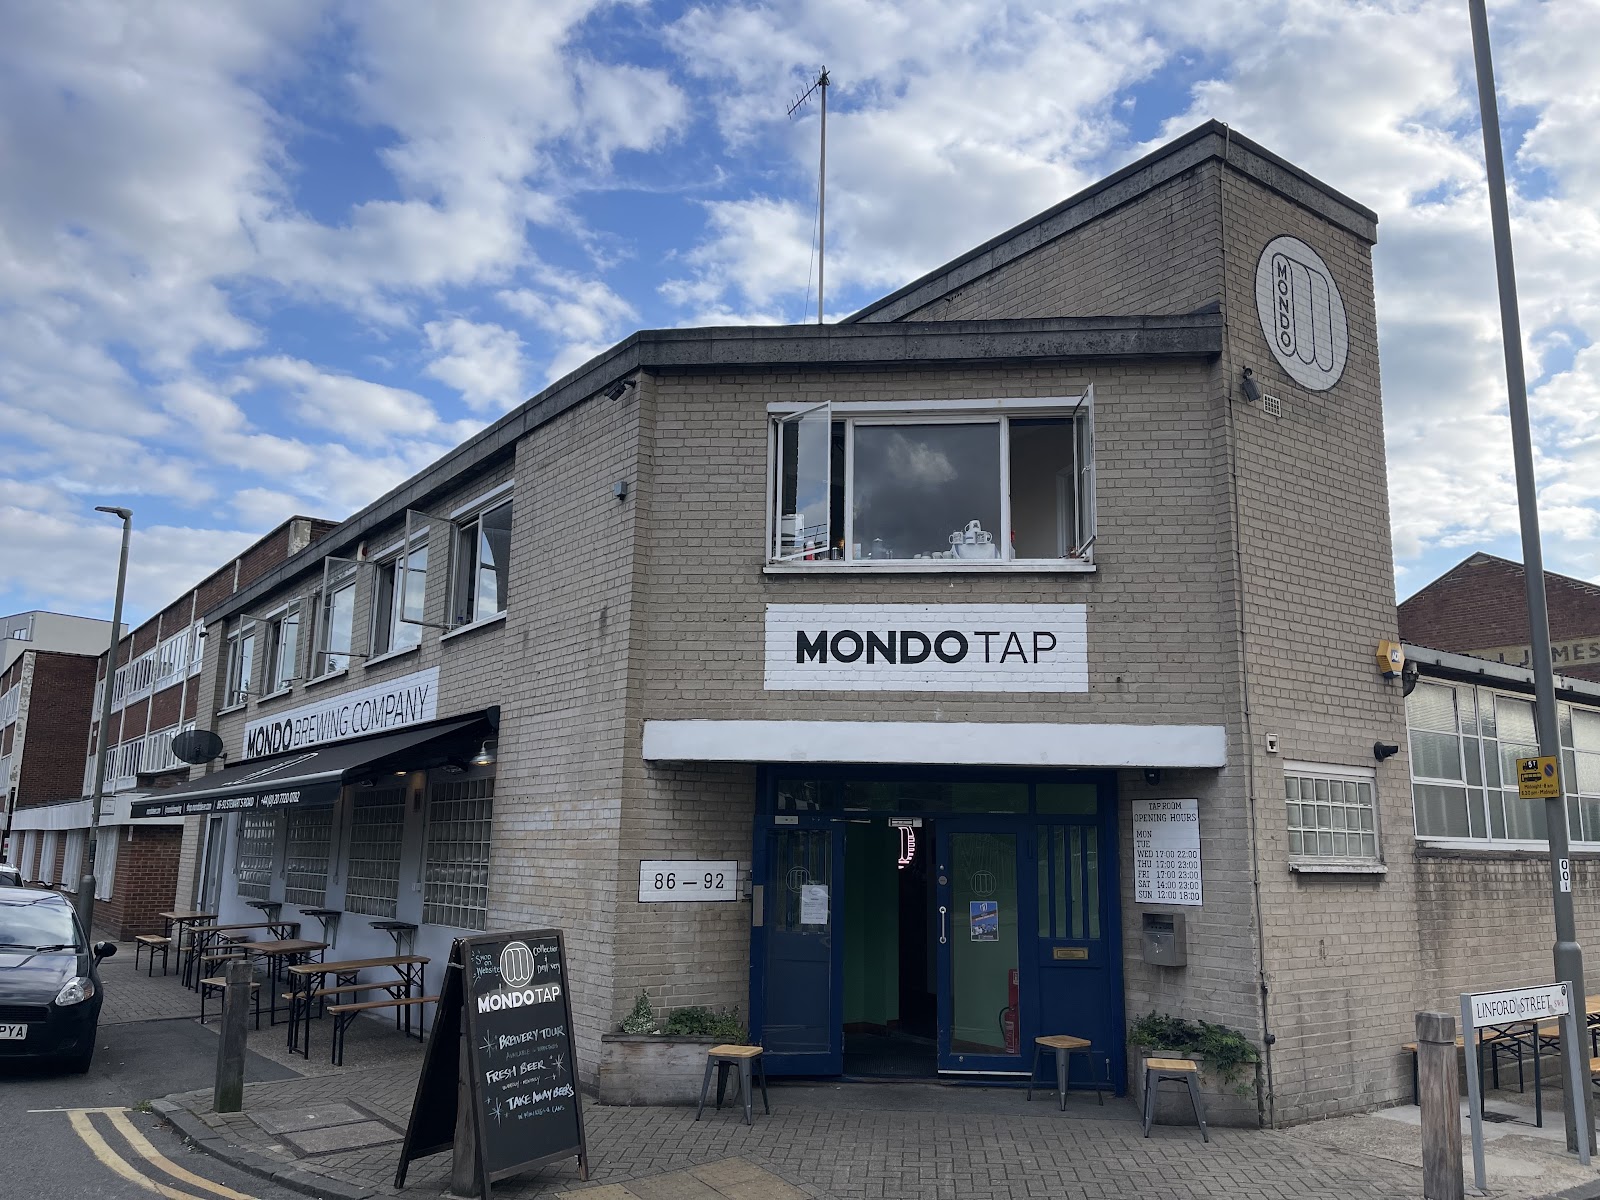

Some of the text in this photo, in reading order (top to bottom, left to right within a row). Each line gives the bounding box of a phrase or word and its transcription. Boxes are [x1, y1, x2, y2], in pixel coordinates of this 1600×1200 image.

[1277, 261, 1291, 348] MONDO
[796, 630, 1057, 664] MONDO TAP
[1519, 642, 1600, 666] JMES
[246, 684, 428, 758] MONDO BREWING COMPANY
[1148, 802, 1182, 810] TAP ROOM
[1134, 813, 1197, 822] OPENING HOURS
[1156, 850, 1174, 858] 17:00
[1177, 850, 1198, 858] 22:00
[1156, 860, 1176, 868] 17:00
[1178, 860, 1198, 869] 23:00
[1138, 870, 1198, 880] FRI 17:00 23:00
[1138, 880, 1198, 890] SAT 14:00 23:00
[1138, 890, 1200, 900] SUN 12:00 18:00
[476, 966, 500, 976] Website
[478, 986, 560, 1014] MONDO TAP
[1476, 999, 1516, 1019] LINFORD
[1520, 994, 1551, 1013] STREET
[499, 1029, 538, 1050] BREWERY
[540, 1025, 566, 1040] TOUR
[486, 1060, 547, 1086] FRESH BEER
[506, 1094, 532, 1110] TAKE
